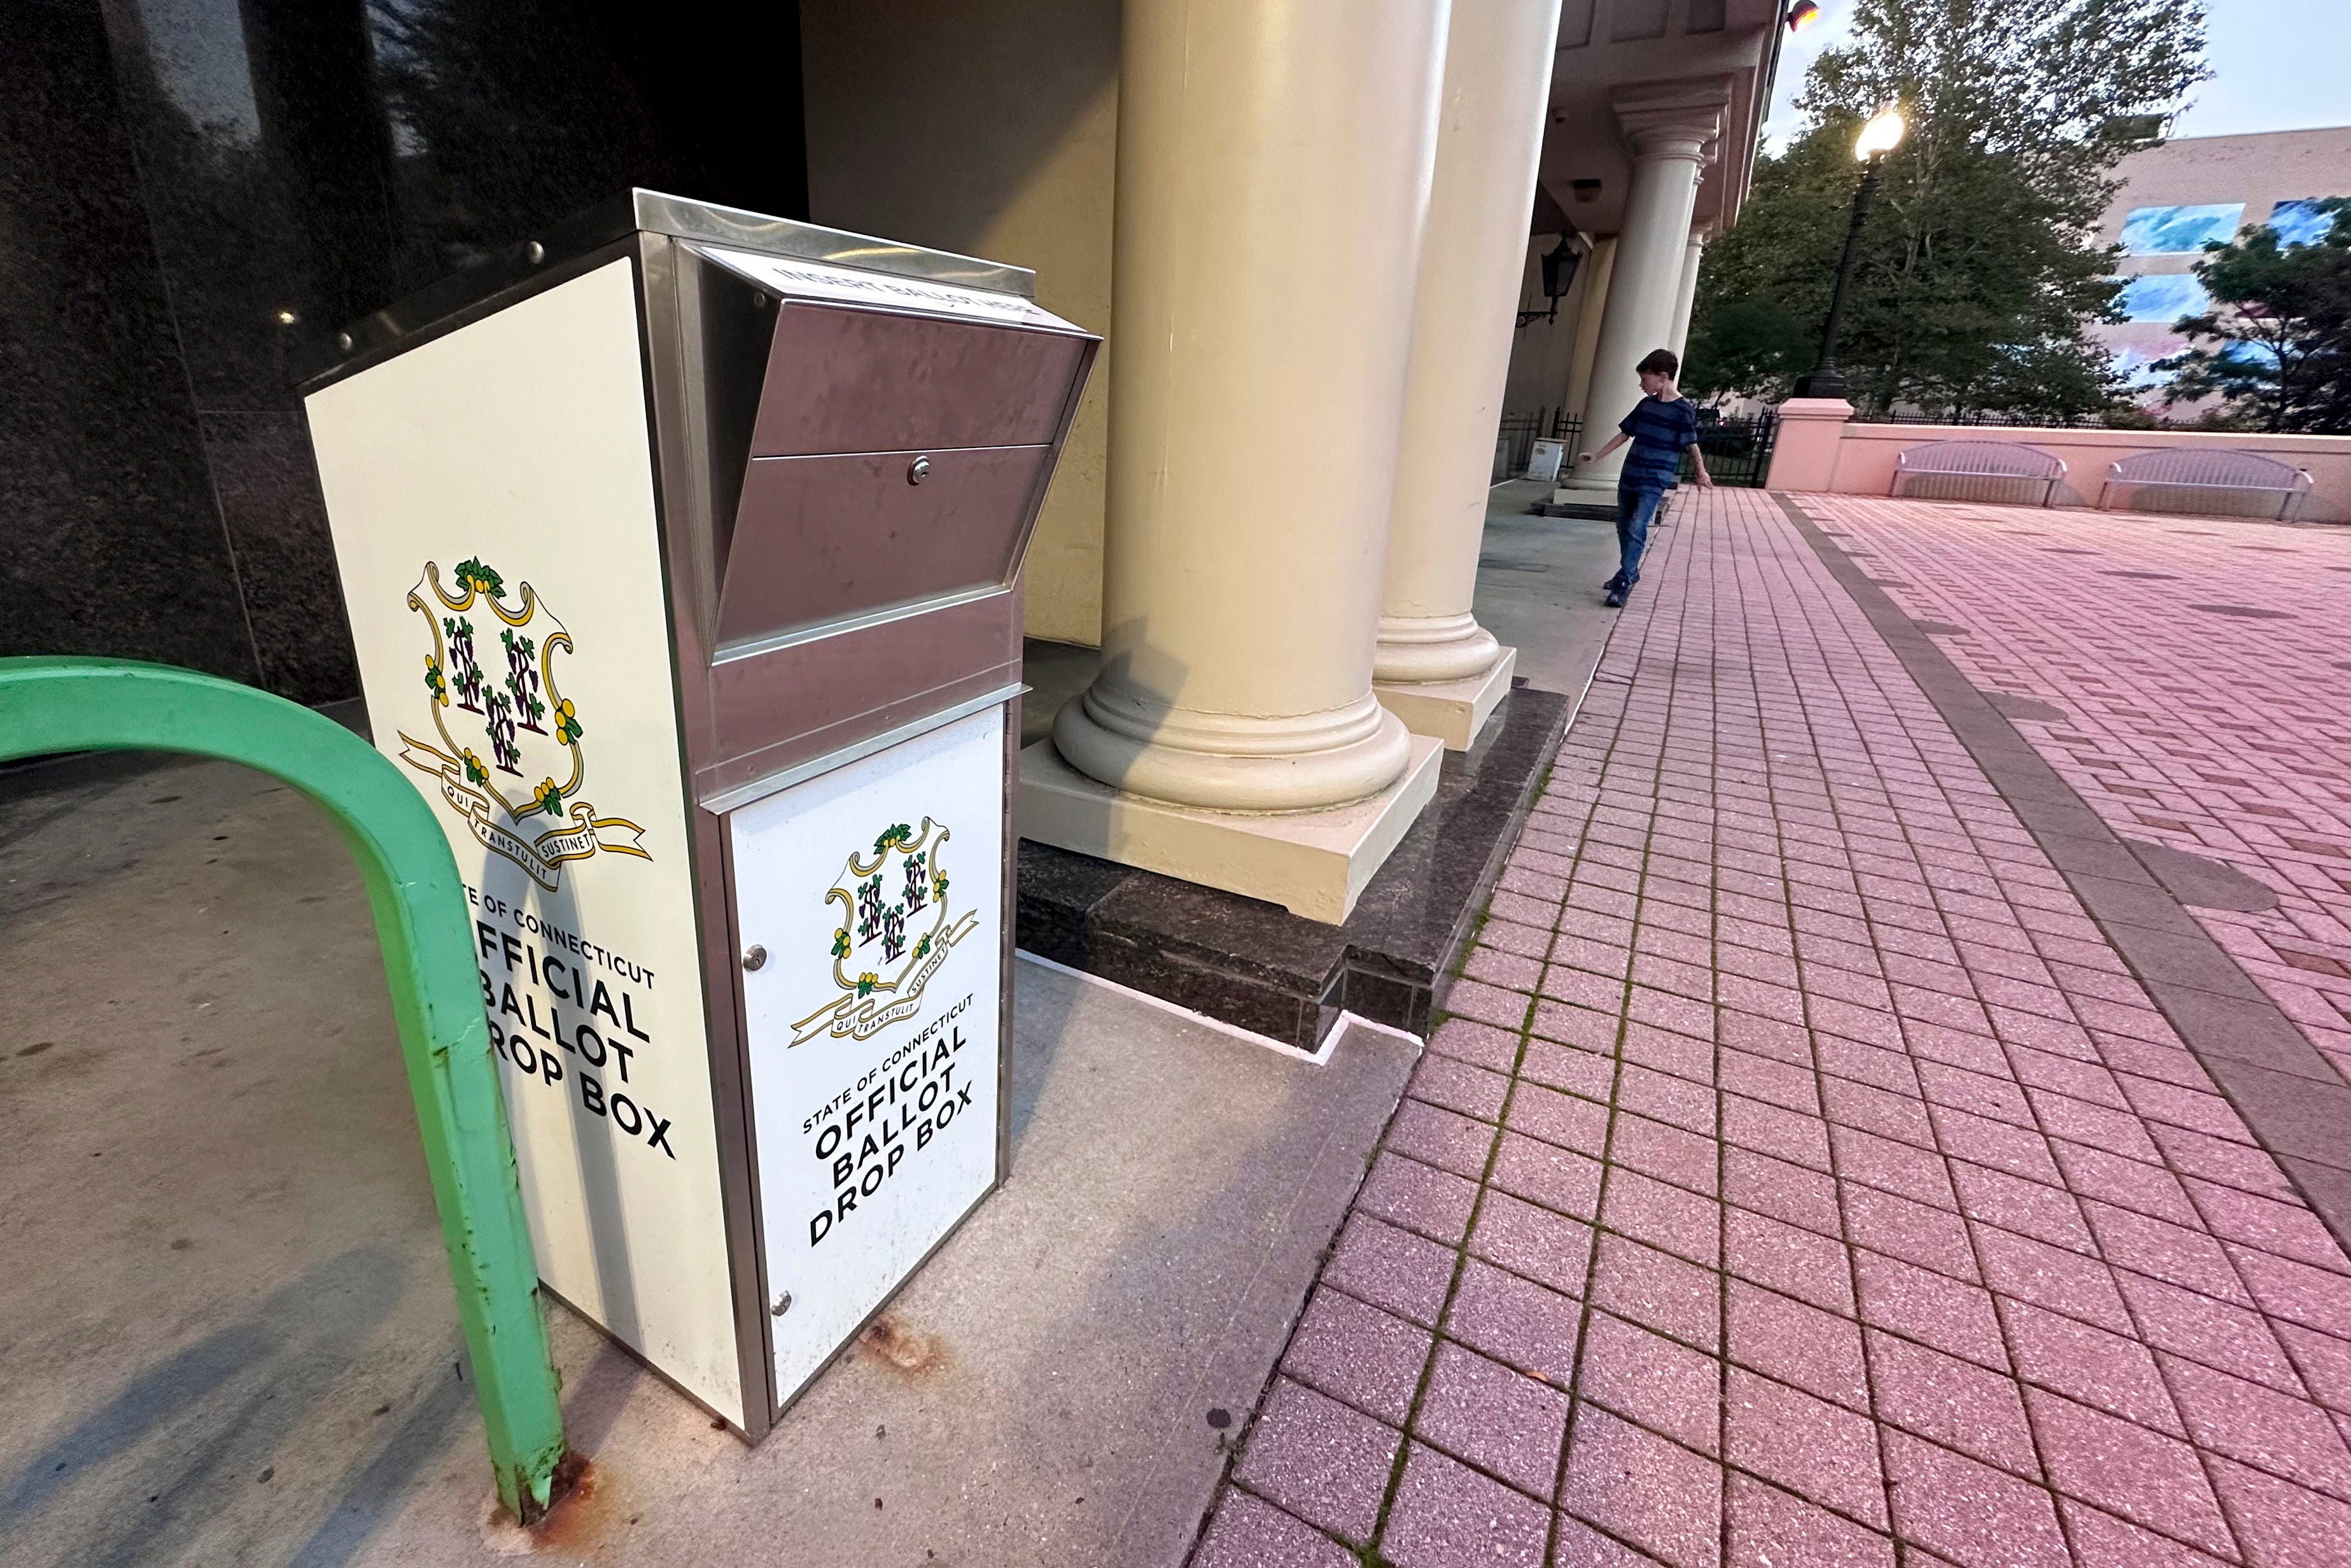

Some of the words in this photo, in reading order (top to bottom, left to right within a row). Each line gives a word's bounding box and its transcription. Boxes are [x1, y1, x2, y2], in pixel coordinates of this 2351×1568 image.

[772, 268, 885, 292] INSERT
[883, 284, 981, 306] BALLOT
[447, 786, 468, 807] QUI
[475, 818, 547, 879] TRANSTULIT
[542, 833, 589, 858] SUSTINET
[477, 920, 650, 1044] FFICIAL
[484, 895, 507, 918] OF
[514, 908, 655, 990] CONNECTICUT
[837, 1016, 856, 1030] QUI
[859, 1003, 914, 1033] TRANSTULIT
[912, 946, 946, 993] SUSTINET
[491, 1020, 563, 1087] ROP
[579, 1071, 677, 1161] BOX
[803, 1088, 852, 1134] STATE
[857, 1068, 877, 1091] OF
[882, 993, 974, 1073] CONNECTICUT
[815, 1026, 967, 1160] OFFICIAL
[833, 1062, 956, 1190] BALLOT
[810, 1144, 905, 1248] DROP
[917, 1079, 972, 1151] BOX
